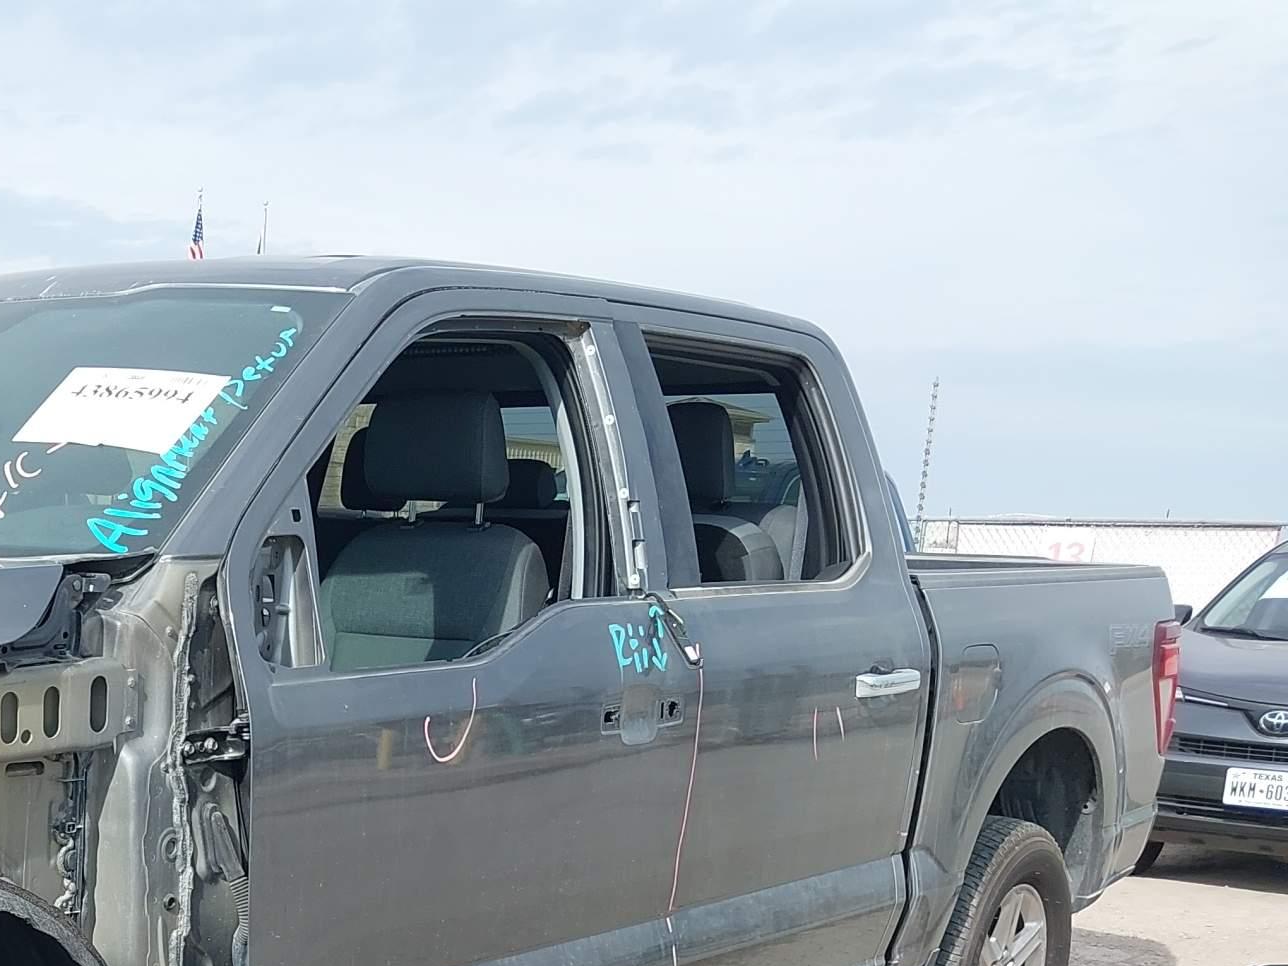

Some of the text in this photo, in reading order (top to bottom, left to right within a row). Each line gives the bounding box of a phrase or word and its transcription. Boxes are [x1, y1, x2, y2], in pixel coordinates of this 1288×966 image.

[71, 383, 195, 404] 43865994
[1048, 542, 1085, 562] 13
[1252, 772, 1284, 782] TEXAS
